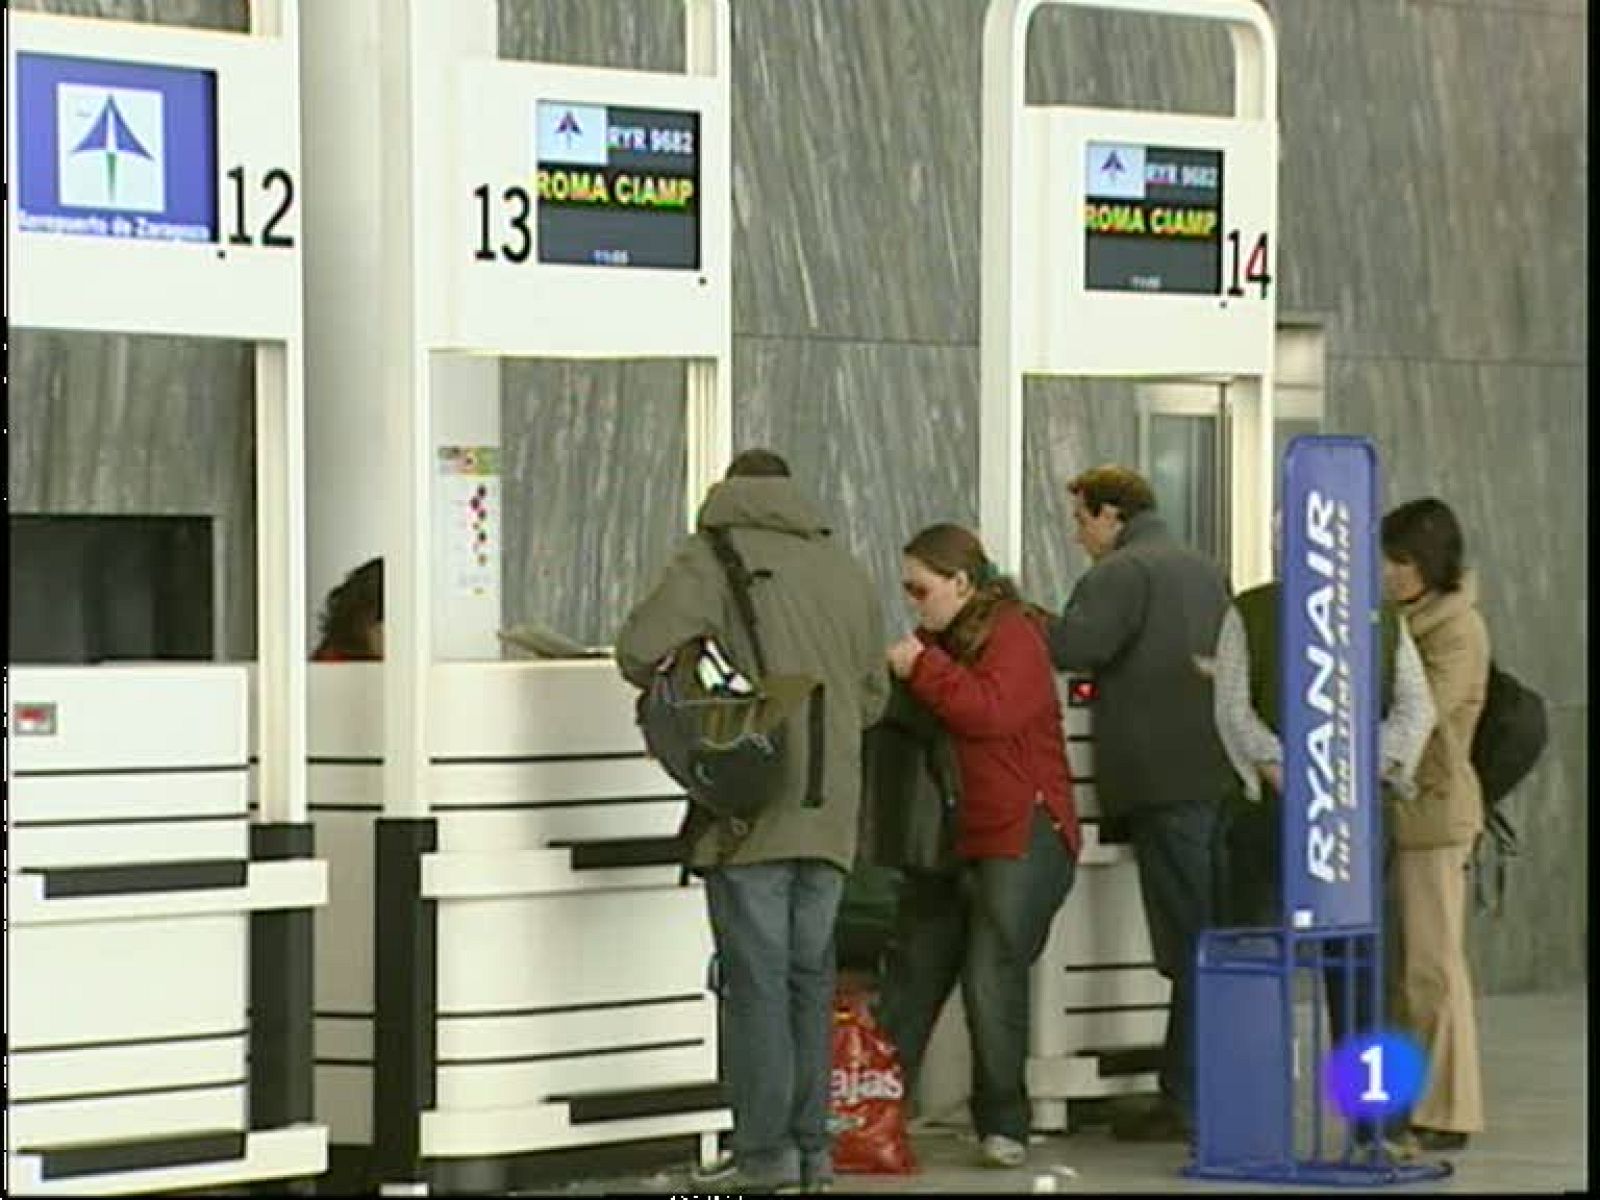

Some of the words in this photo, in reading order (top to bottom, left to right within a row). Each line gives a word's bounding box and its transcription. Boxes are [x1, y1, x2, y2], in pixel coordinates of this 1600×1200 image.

[226, 165, 295, 247] 12
[474, 183, 532, 263] 13
[536, 170, 610, 203] ROMA
[614, 174, 694, 207] CIAMP
[1085, 203, 1145, 235] ROMA
[1150, 207, 1218, 237] CIAMP
[1227, 229, 1272, 300] 14
[1306, 489, 1337, 883] RYANAIR
